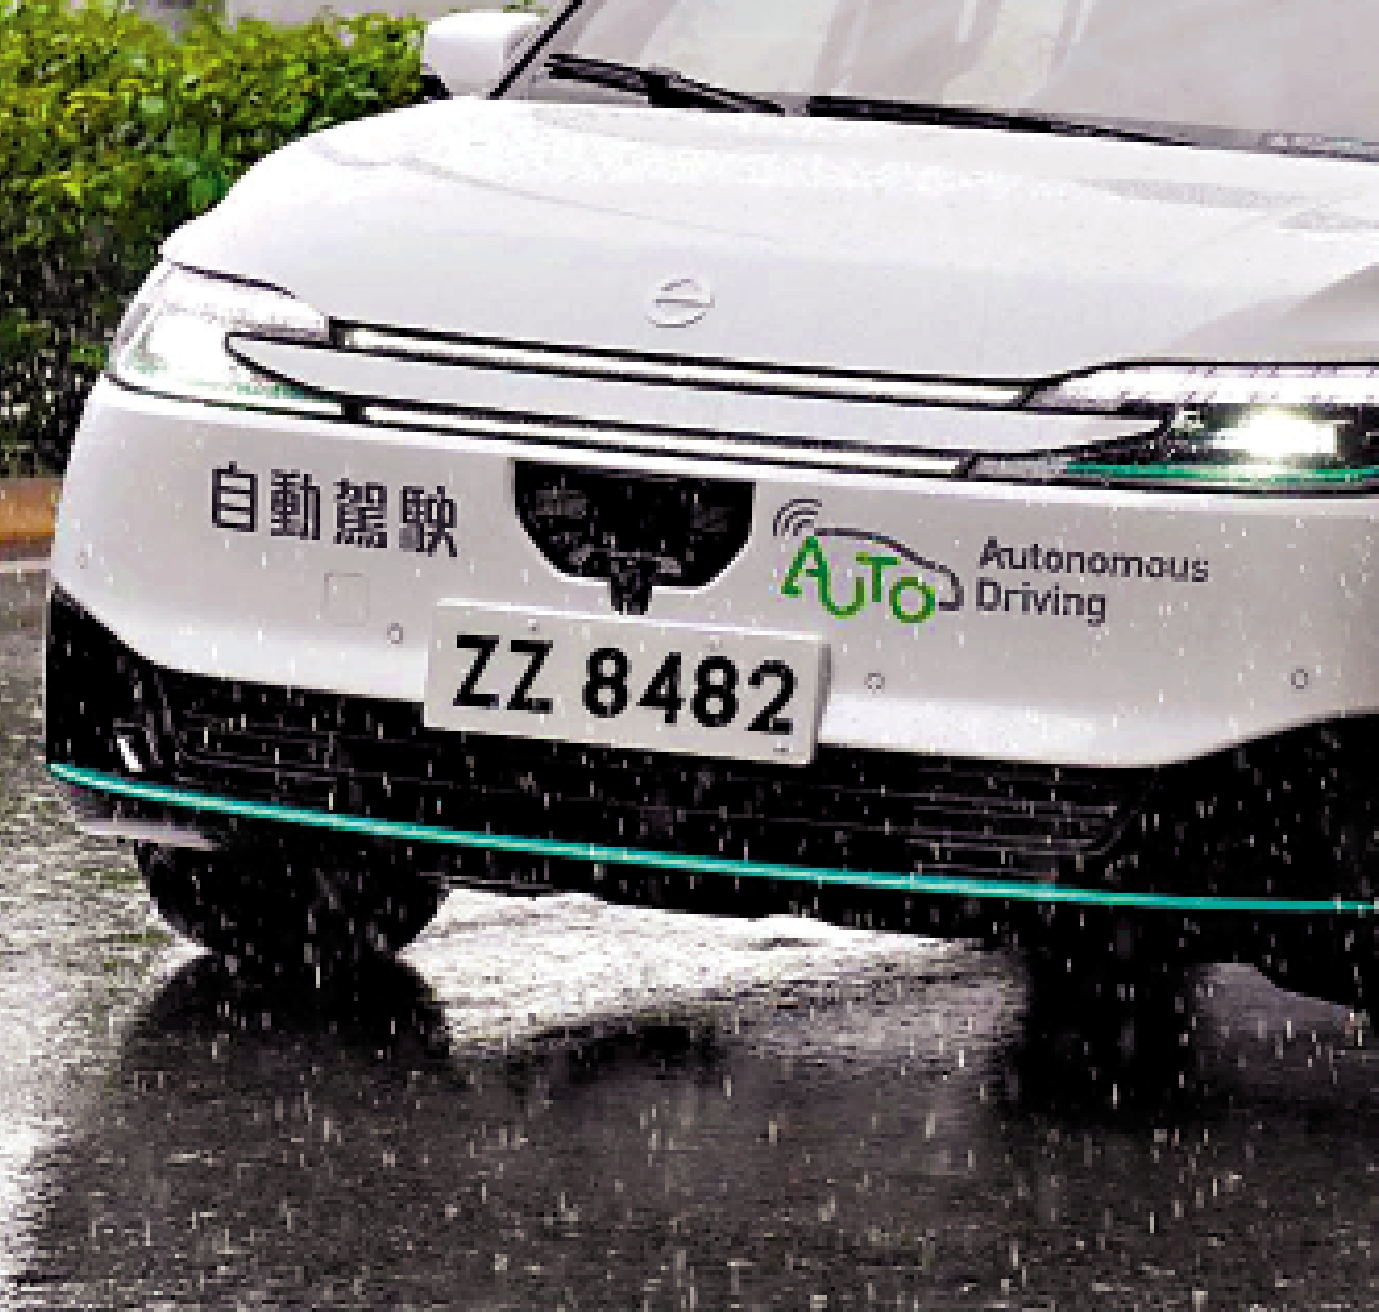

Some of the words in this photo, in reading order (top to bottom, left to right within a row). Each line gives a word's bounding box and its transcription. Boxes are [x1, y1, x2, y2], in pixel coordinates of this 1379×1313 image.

[211, 460, 459, 559] 自動駕駛
[979, 535, 1210, 582] Autonomous
[974, 576, 1107, 628] Driving
[451, 633, 555, 715] ZZ
[581, 646, 798, 737] 8482
